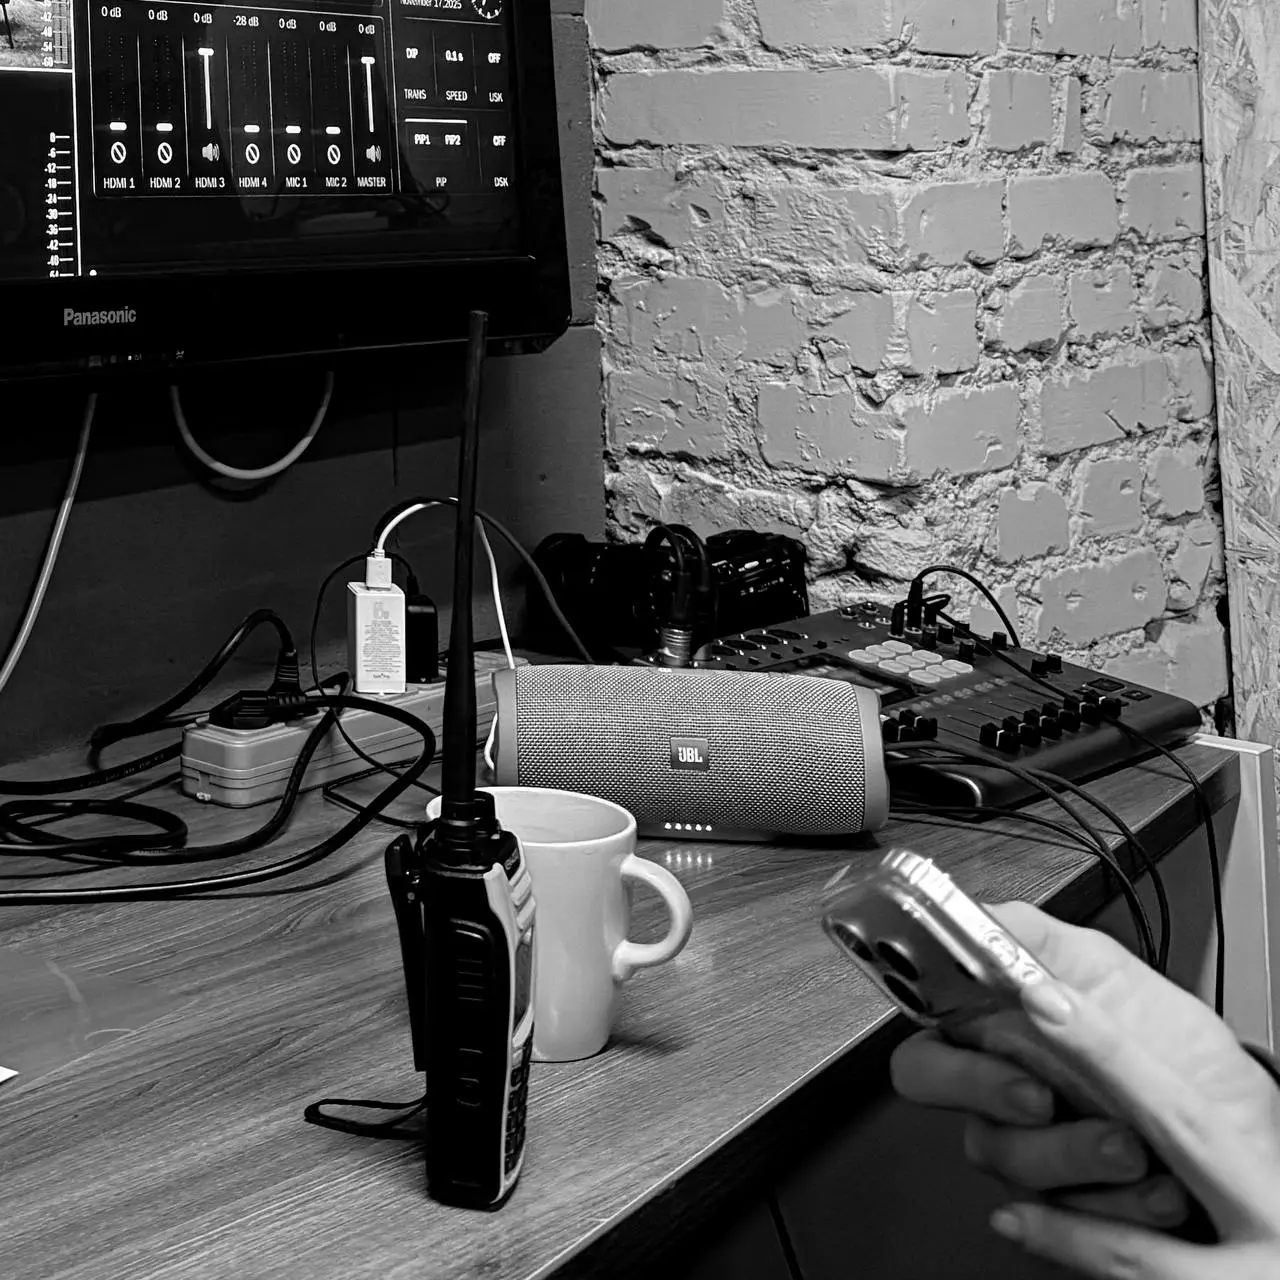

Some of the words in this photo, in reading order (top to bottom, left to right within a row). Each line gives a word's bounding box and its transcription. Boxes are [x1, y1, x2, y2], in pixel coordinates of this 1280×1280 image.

[101, 6, 108, 17] 0
[109, 7, 122, 18] dB
[148, 9, 155, 20] 0
[156, 10, 168, 20] dB
[193, 12, 200, 23] 0
[201, 13, 213, 24] dB
[233, 15, 247, 26] -28
[249, 16, 259, 27] dB
[279, 18, 285, 28] 0
[286, 18, 297, 29] dB
[320, 21, 326, 31] 0
[326, 21, 337, 32] dB
[358, 24, 364, 34] 0
[365, 24, 375, 34] dB
[488, 53, 501, 63] OFF
[404, 88, 427, 100] TRANS
[446, 90, 468, 101] SPEED
[489, 92, 503, 103] USK
[493, 135, 506, 146] OFF
[103, 177, 127, 189] HDMI
[129, 177, 135, 189] 1
[150, 177, 173, 188] HDMI
[174, 177, 181, 188] 2
[195, 177, 217, 188] HDMI
[218, 177, 225, 188] 3
[238, 177, 260, 188] HDMI
[261, 177, 267, 188] 4
[285, 177, 300, 188] MIC
[302, 177, 308, 188] 1
[325, 177, 340, 188] MIC
[341, 177, 347, 188] 2
[357, 177, 386, 188] MASTER
[494, 177, 509, 188] DSK
[63, 305, 137, 326] Panasonic
[677, 746, 703, 763] JBL
